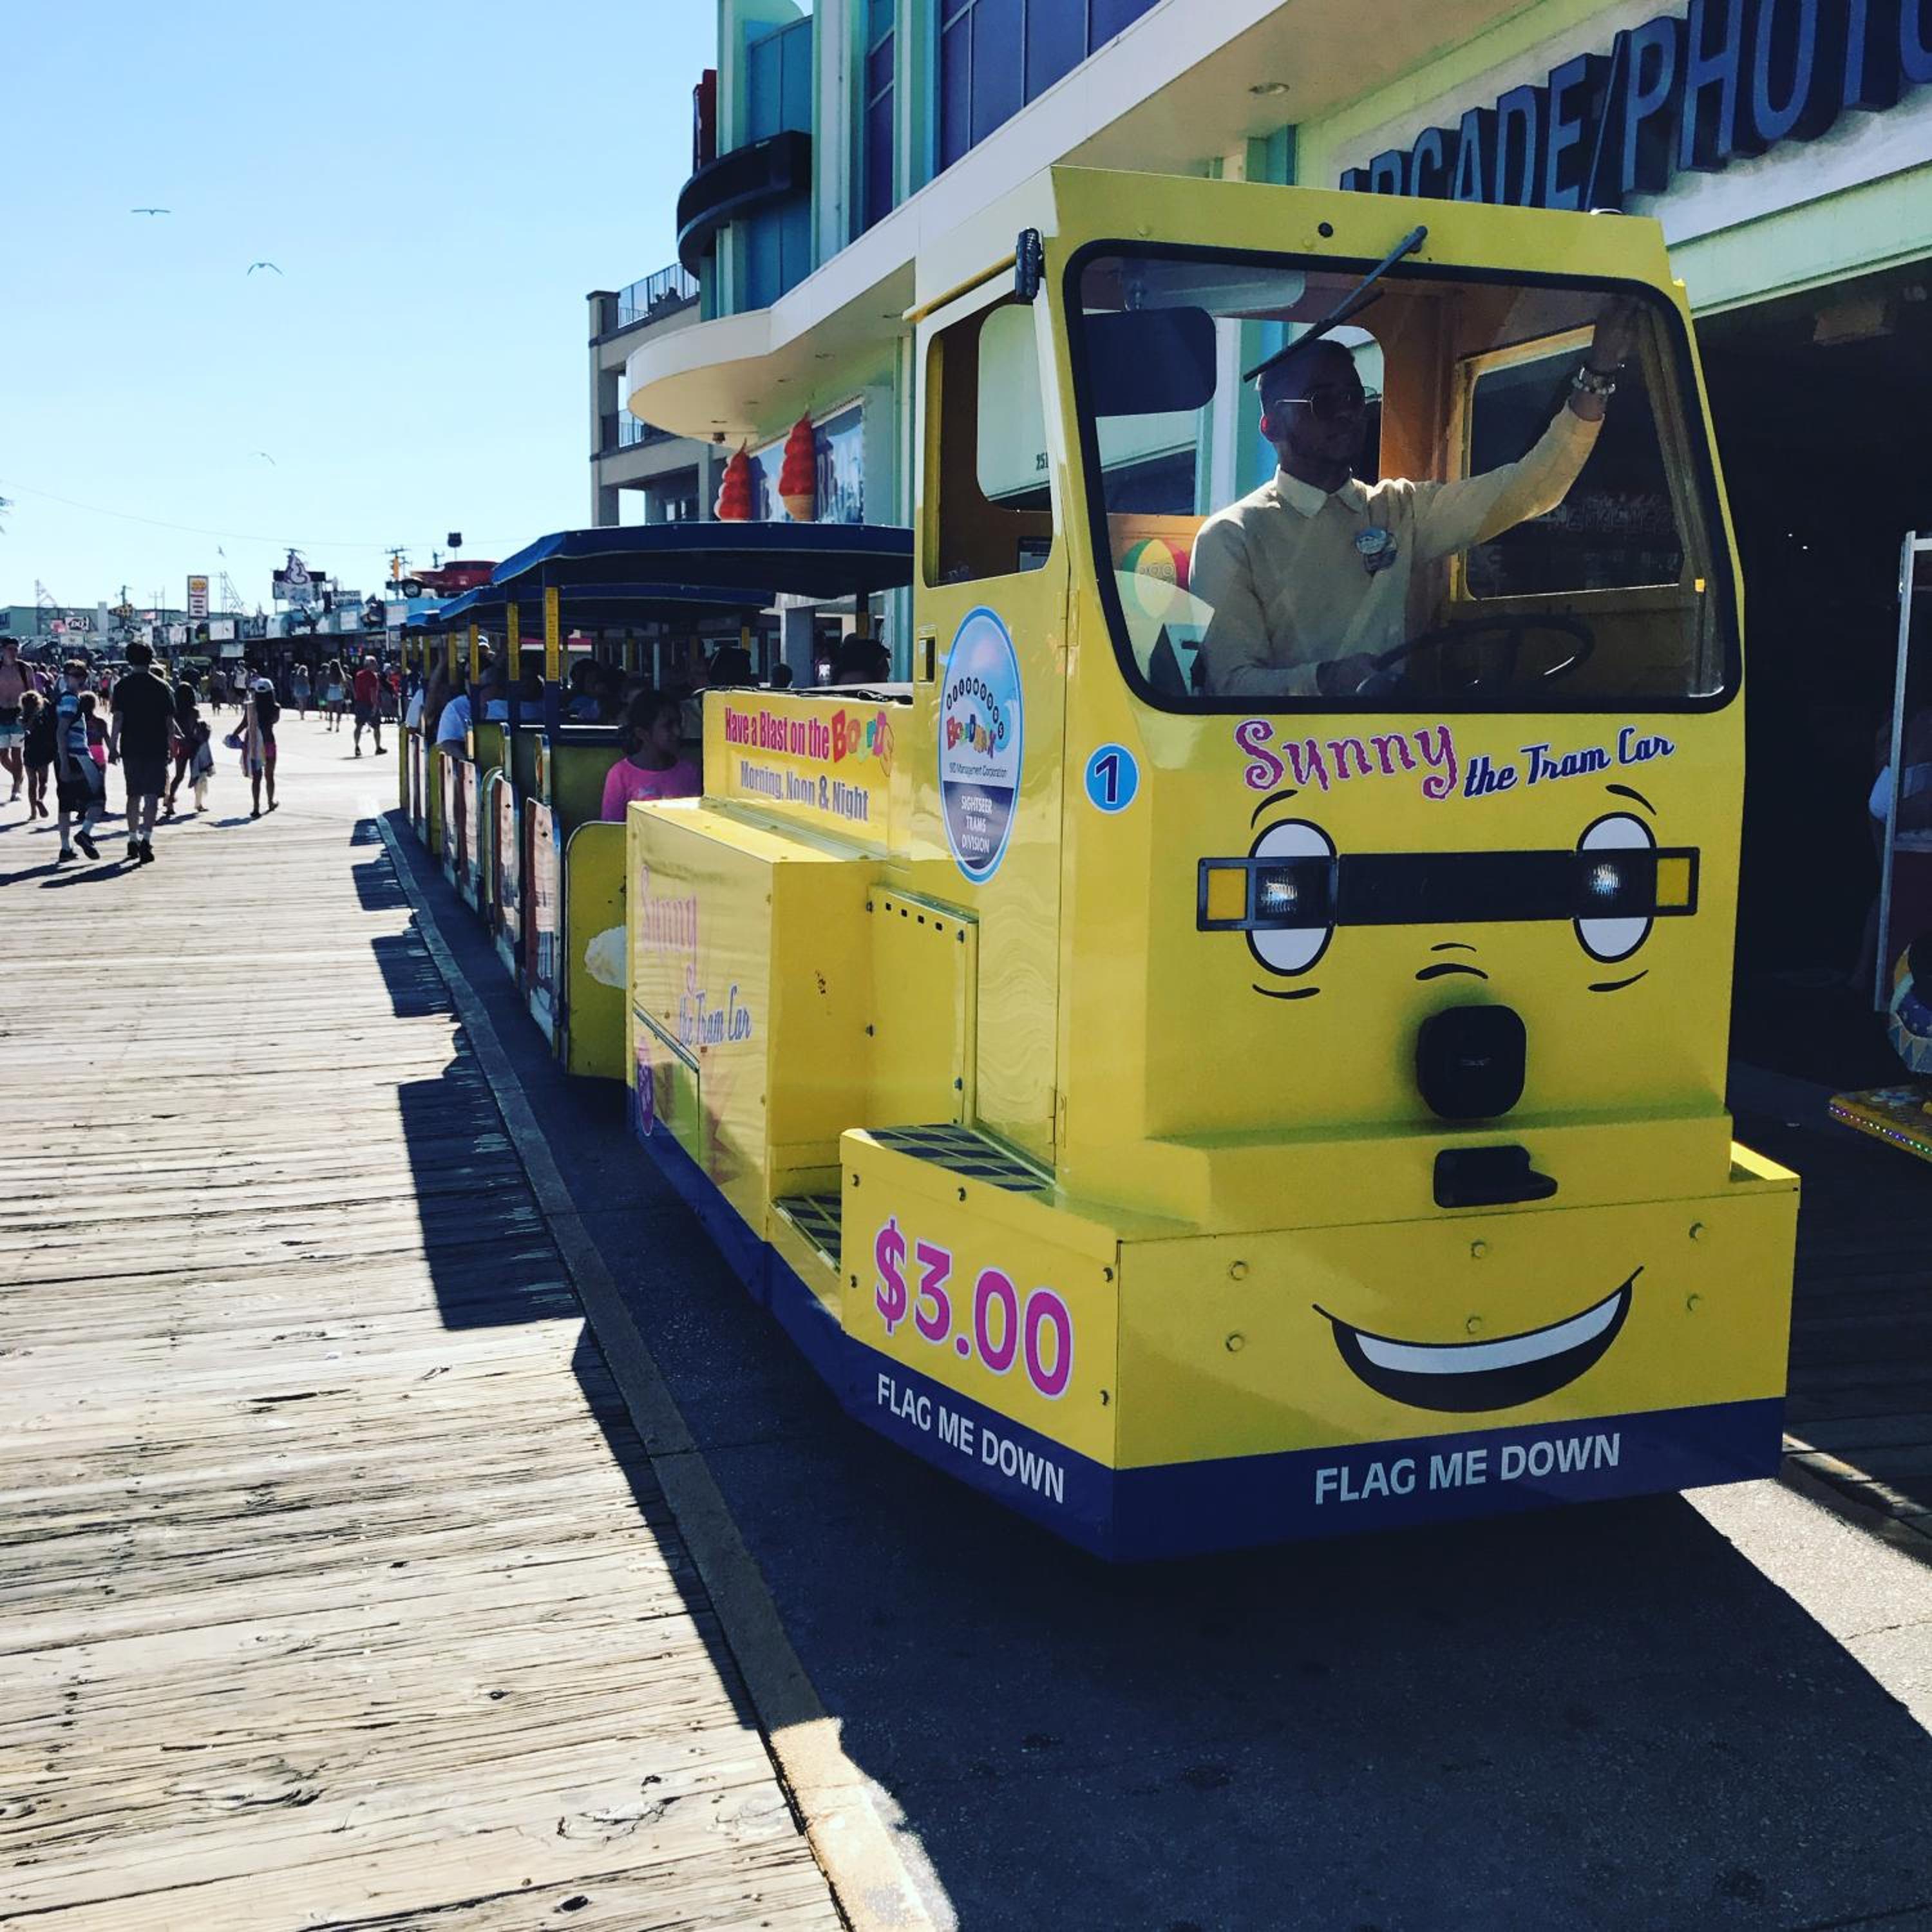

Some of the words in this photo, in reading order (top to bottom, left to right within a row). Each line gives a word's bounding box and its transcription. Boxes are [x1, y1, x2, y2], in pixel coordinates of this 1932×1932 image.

[725, 707, 749, 745] Have
[752, 719, 757, 747] a
[760, 711, 788, 752] Blast
[791, 720, 805, 755] on
[808, 717, 829, 760] the
[1234, 719, 1458, 800] Sunny
[1463, 755, 1518, 798] the
[1520, 743, 1611, 785] Tram
[1617, 726, 1675, 766] Car
[741, 761, 784, 800] Morning,
[786, 771, 815, 806] Noon
[819, 775, 829, 810] &
[833, 781, 868, 821] Night
[1095, 753, 1119, 804] 1
[961, 836, 990, 853] DIVISION
[695, 991, 724, 1045] Tram
[728, 983, 752, 1041] Car
[875, 1217, 1073, 1399] $3.00
[877, 1372, 931, 1432] FLAG
[938, 1406, 974, 1455] ME
[982, 1428, 1064, 1504] DOWN
[1315, 1458, 1416, 1505] FLAG
[1429, 1449, 1488, 1491] ME
[1501, 1432, 1620, 1481] DOWN
